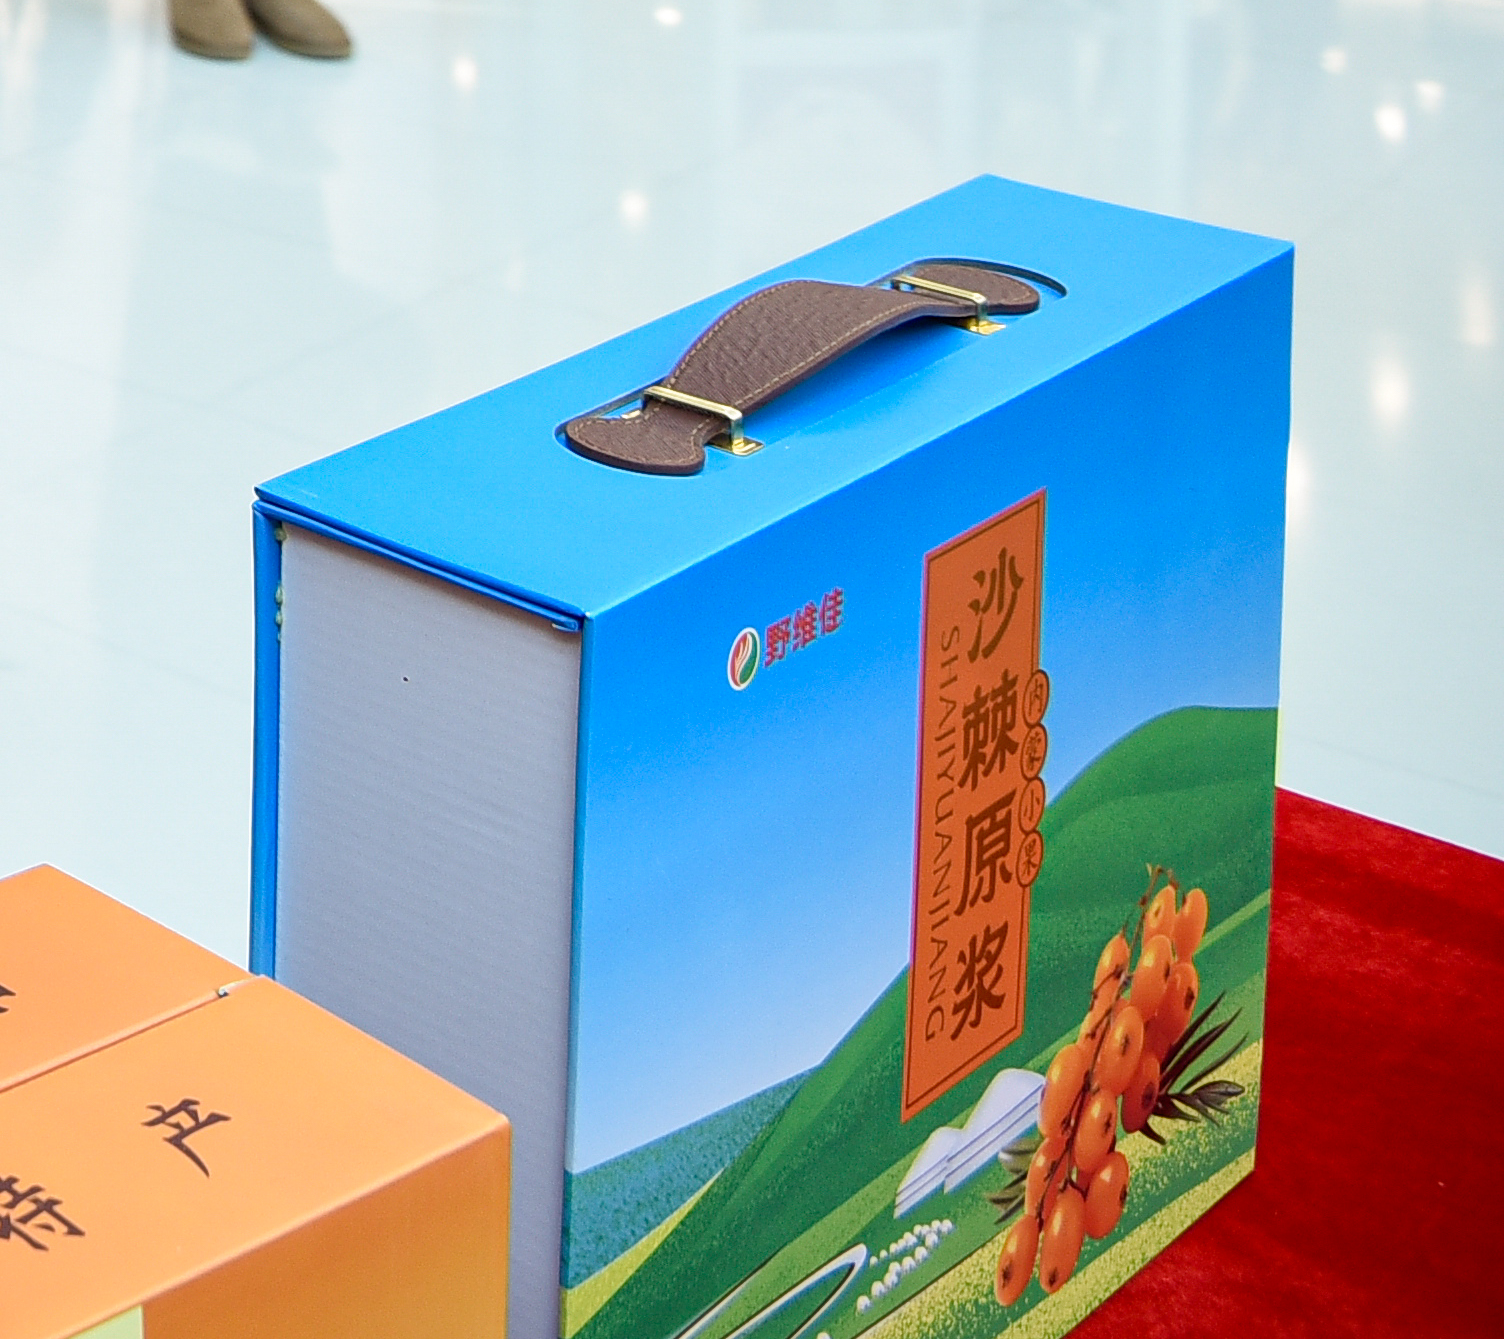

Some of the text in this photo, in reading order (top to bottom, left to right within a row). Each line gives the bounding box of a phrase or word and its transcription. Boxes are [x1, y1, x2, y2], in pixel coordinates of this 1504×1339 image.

[924, 625, 961, 1042] SHAJIYUANJIANG
[950, 547, 1024, 1042] 沙棘原浆
